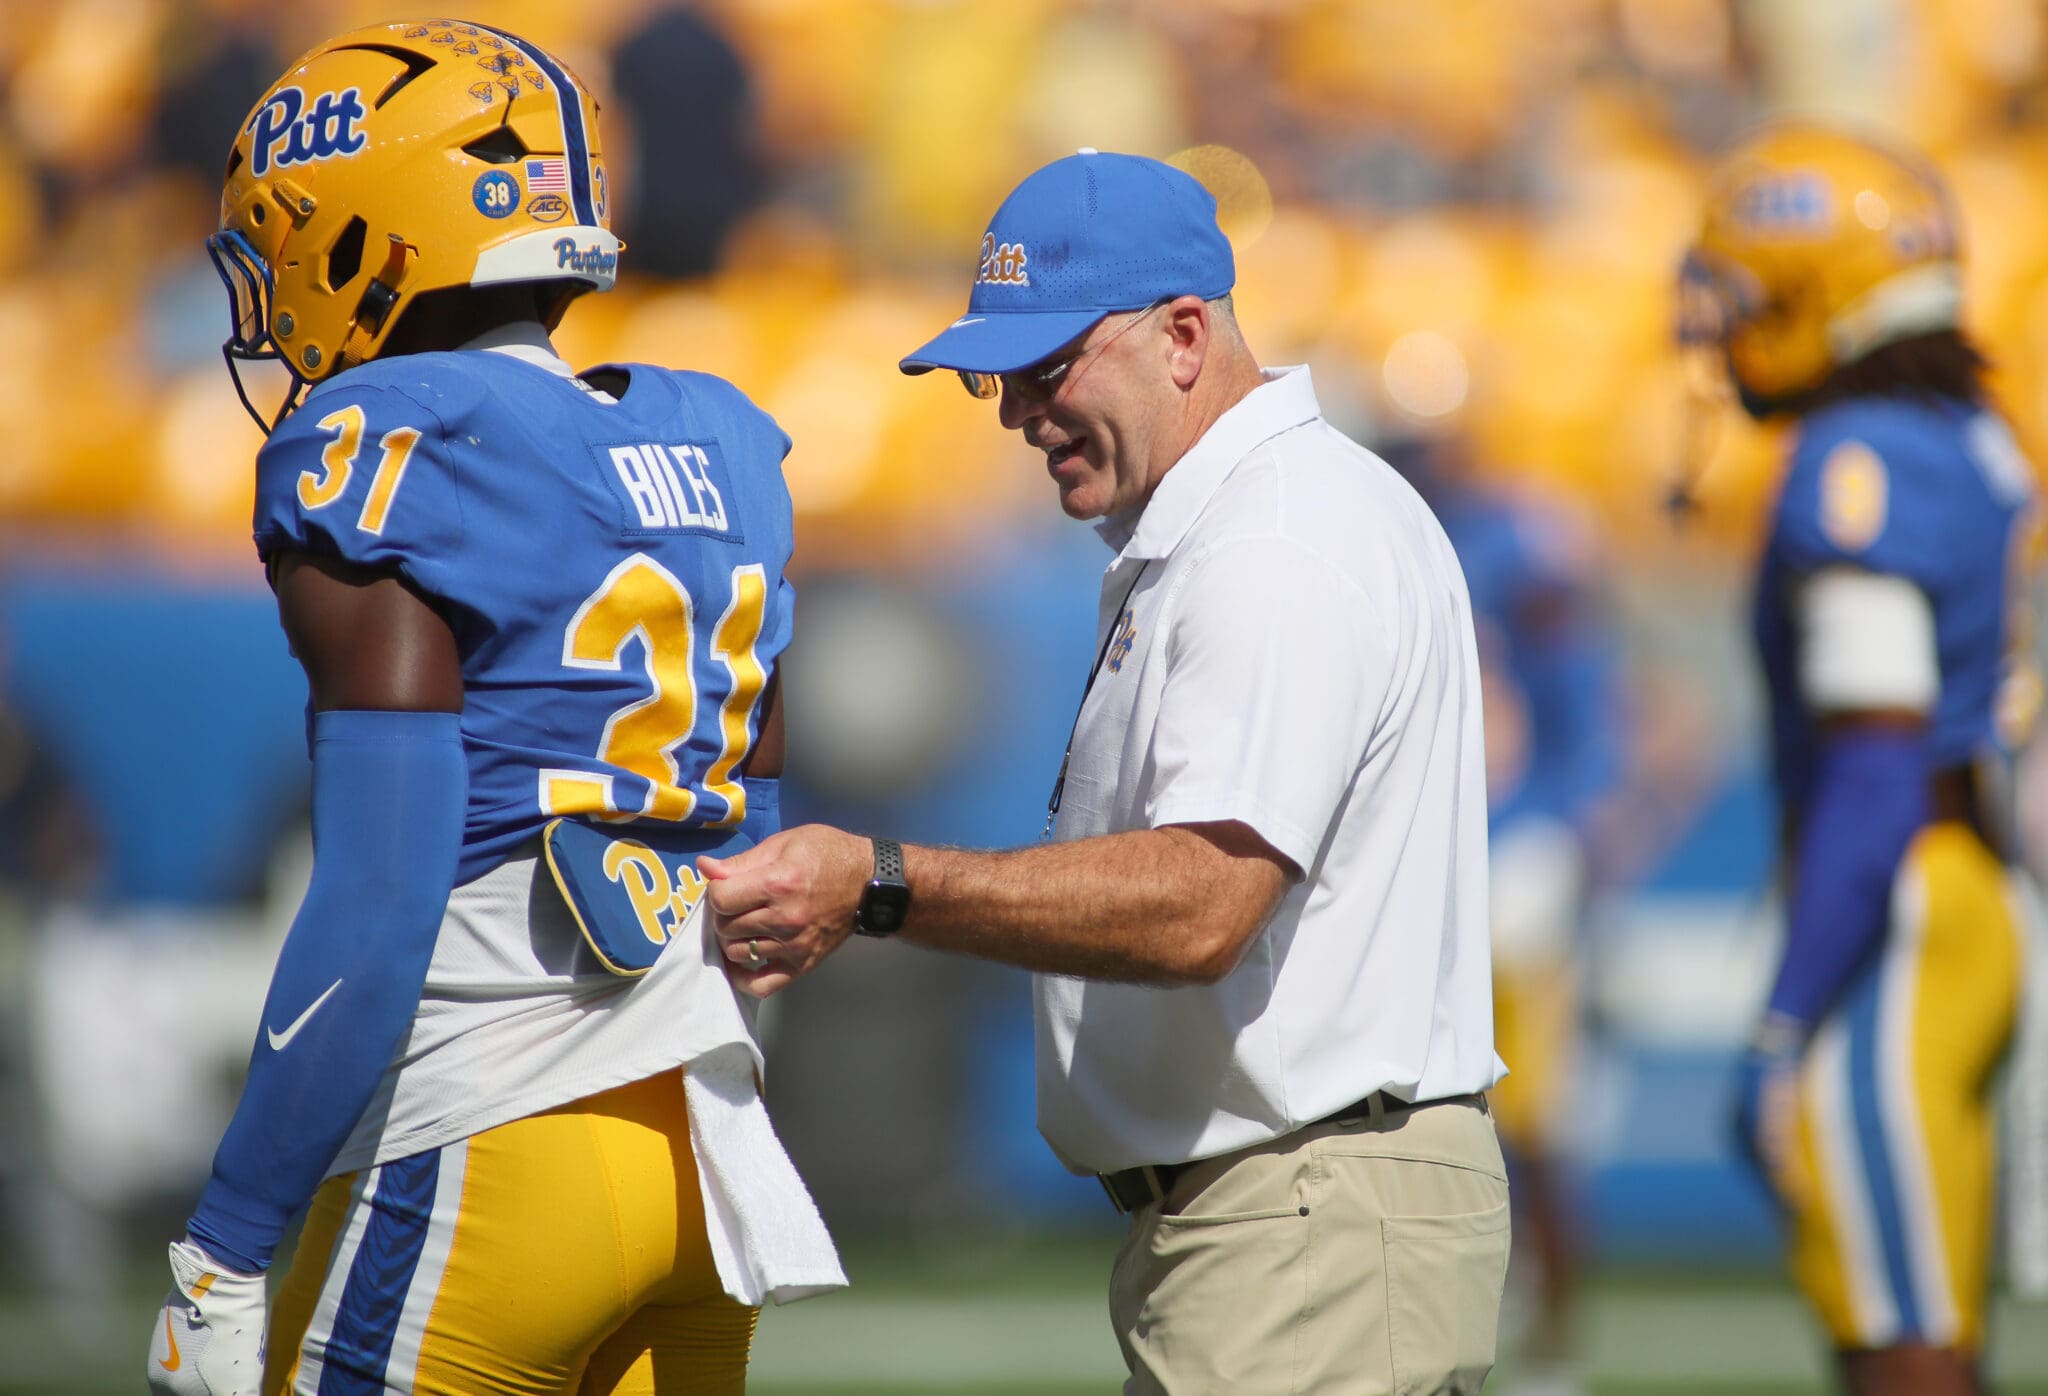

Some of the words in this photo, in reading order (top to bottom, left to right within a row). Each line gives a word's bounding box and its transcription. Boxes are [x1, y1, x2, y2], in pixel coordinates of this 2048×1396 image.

[245, 86, 367, 178] Pitt
[484, 181, 509, 207] 38
[533, 200, 563, 213] ACC
[975, 231, 1028, 285] Pitt
[297, 405, 423, 536] 31
[608, 444, 729, 532] BILES
